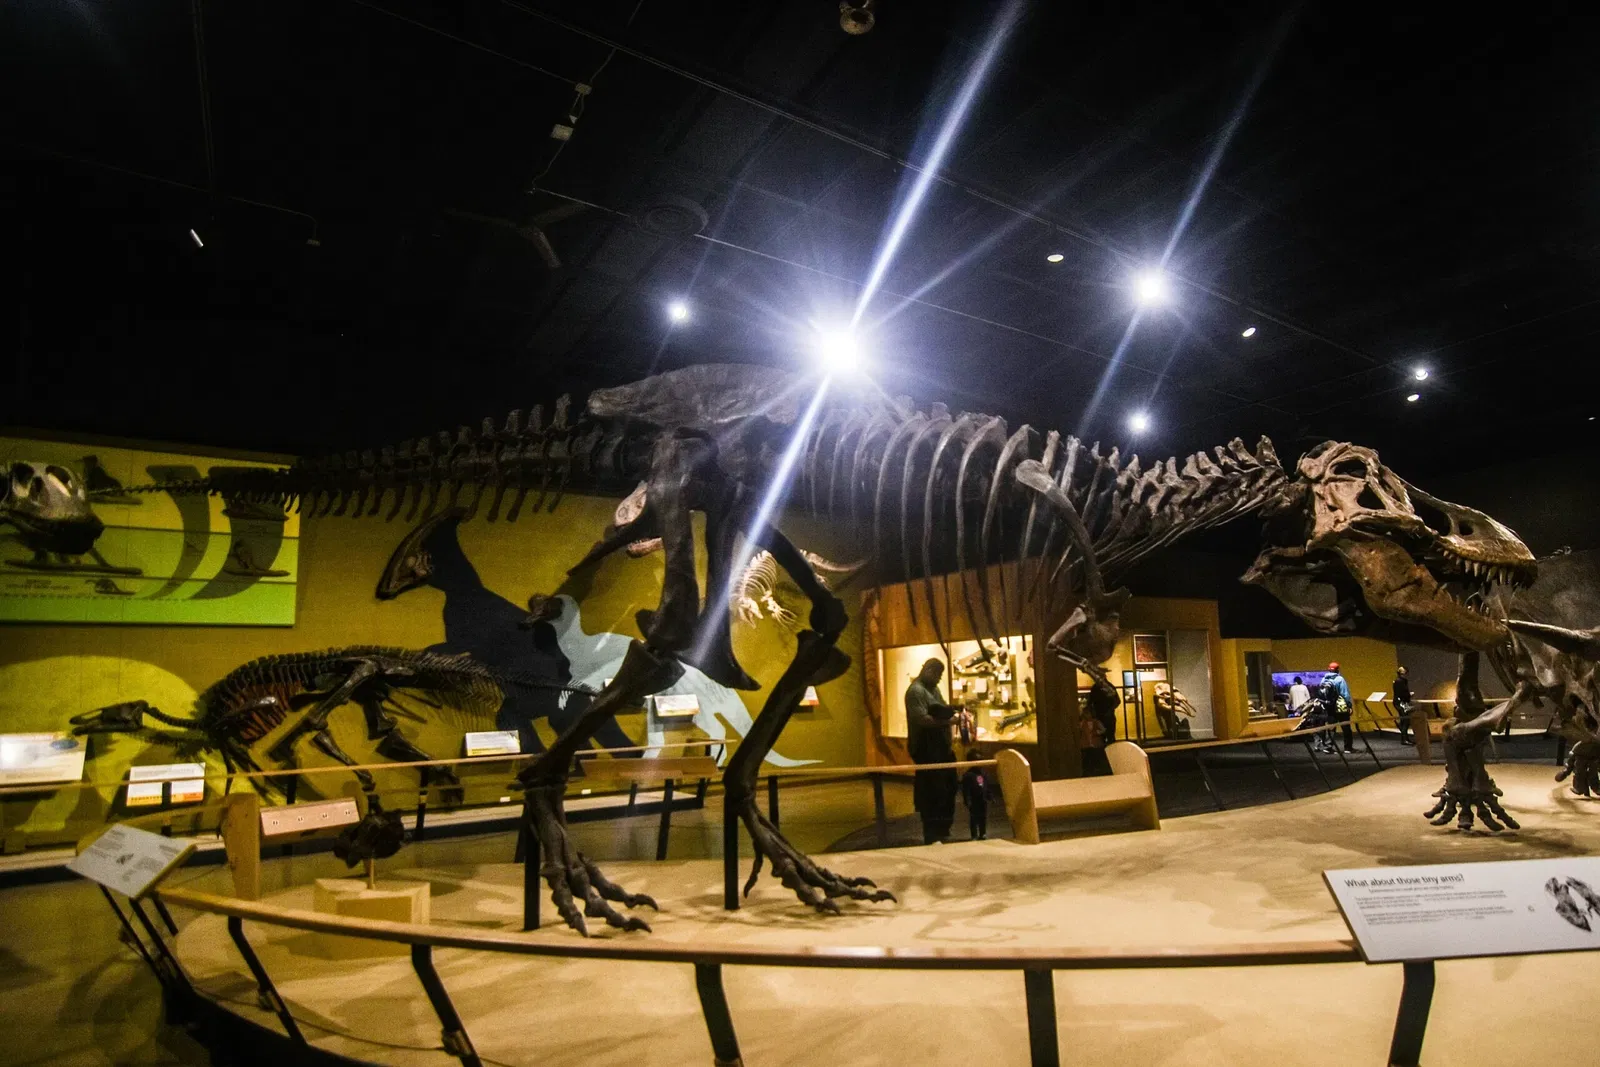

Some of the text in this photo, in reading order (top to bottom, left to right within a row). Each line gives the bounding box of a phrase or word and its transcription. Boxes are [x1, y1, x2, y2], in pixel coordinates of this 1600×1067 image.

[1344, 873, 1465, 887] What about those tiny arms?
